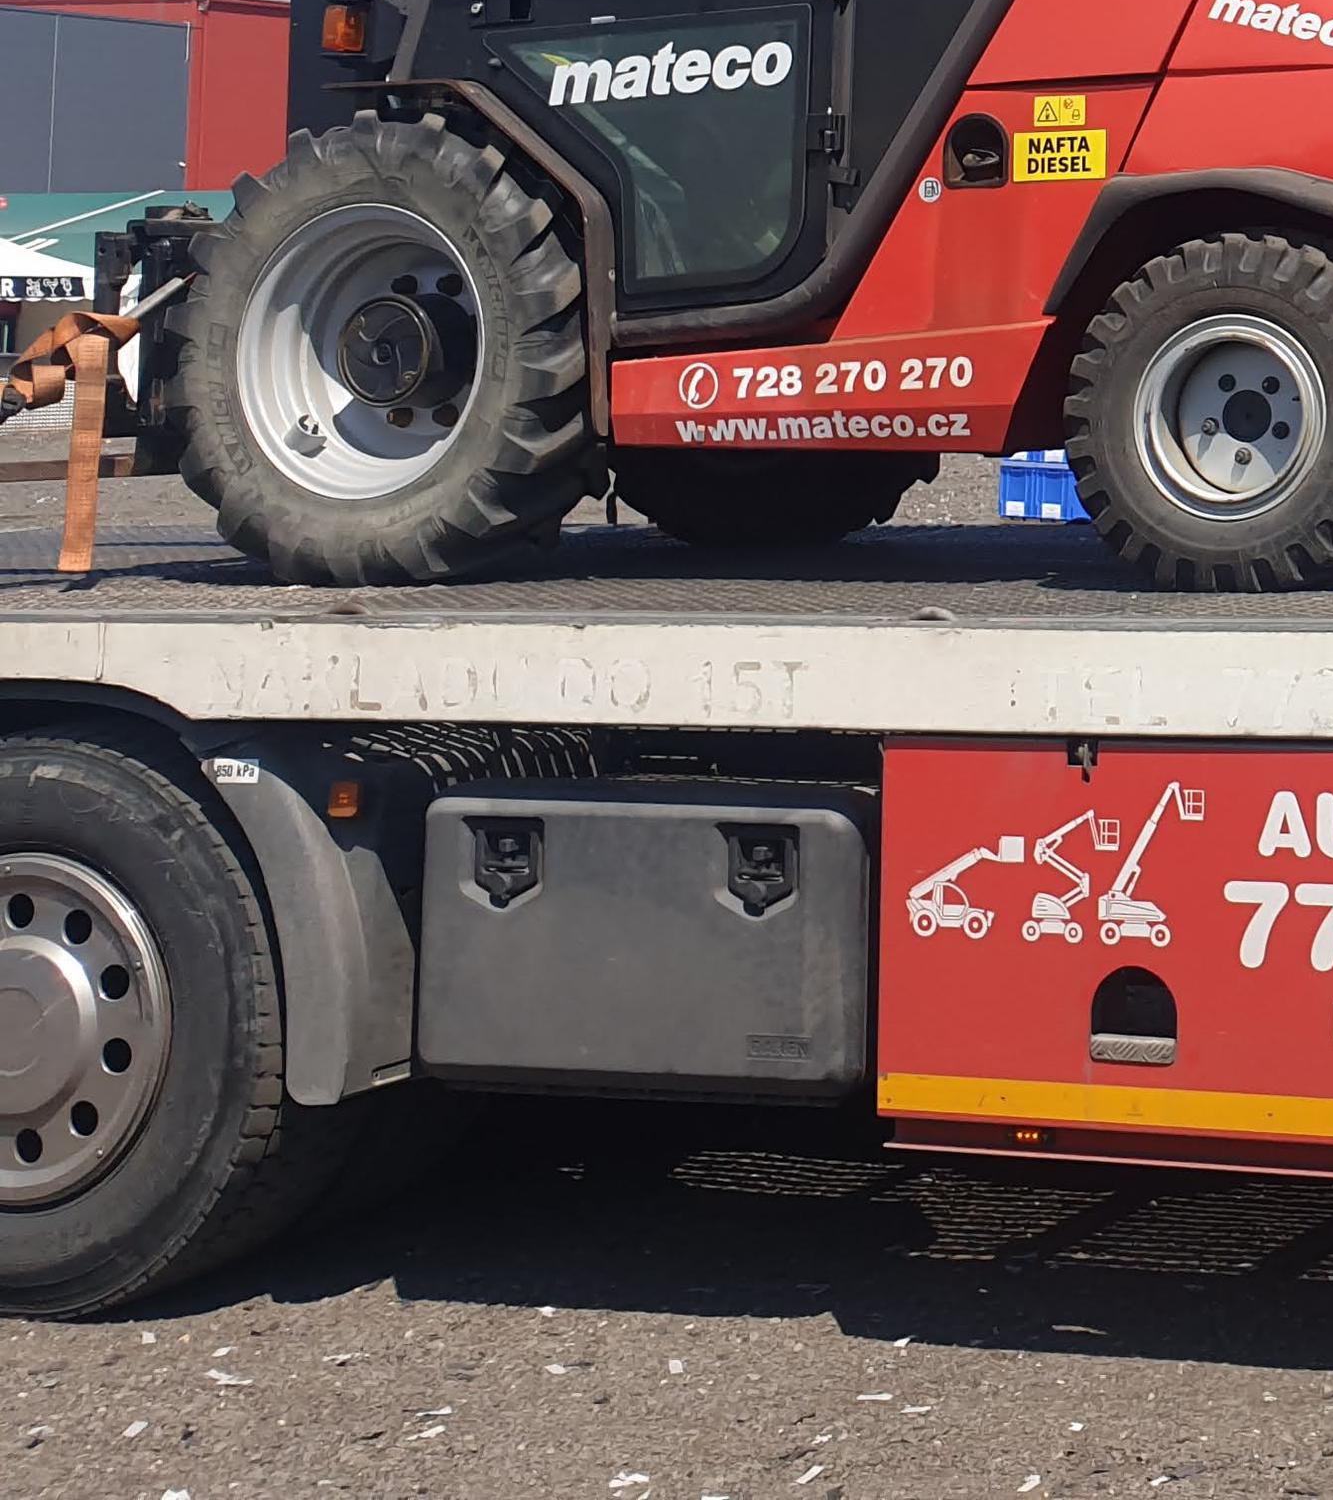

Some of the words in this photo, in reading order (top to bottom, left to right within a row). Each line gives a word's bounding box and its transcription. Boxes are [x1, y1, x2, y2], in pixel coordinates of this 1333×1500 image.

[549, 41, 794, 107] mateco
[1028, 136, 1090, 154] NAFTA
[1027, 156, 1091, 174] DIESEL
[733, 364, 803, 399] 728
[815, 360, 887, 395] 270
[900, 356, 973, 390] 270
[676, 409, 971, 443] www.mateco.cz
